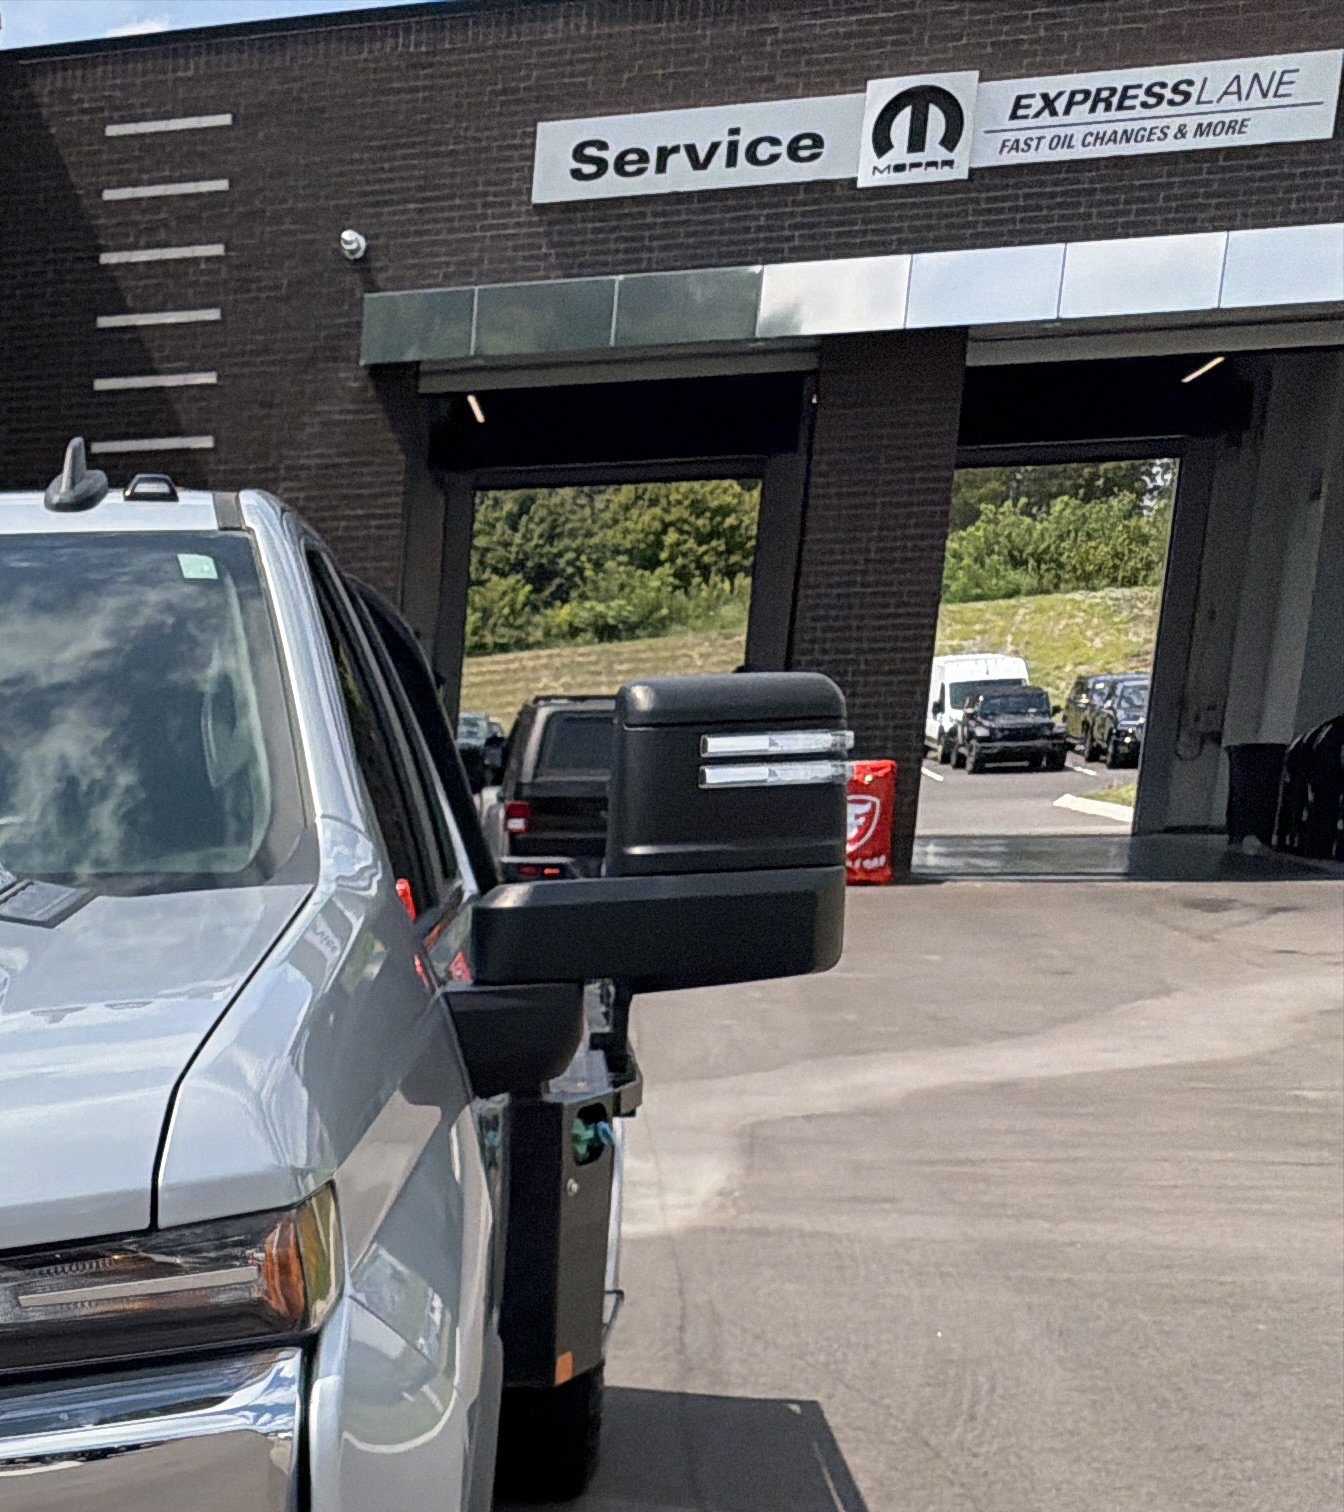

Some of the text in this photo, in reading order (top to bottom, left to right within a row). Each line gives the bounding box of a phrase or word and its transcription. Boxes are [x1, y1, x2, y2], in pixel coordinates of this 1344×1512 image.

[569, 126, 825, 182] Service
[998, 117, 1252, 156] FAST OIL CHANGES & MORE
[870, 158, 957, 177] MOPAR
